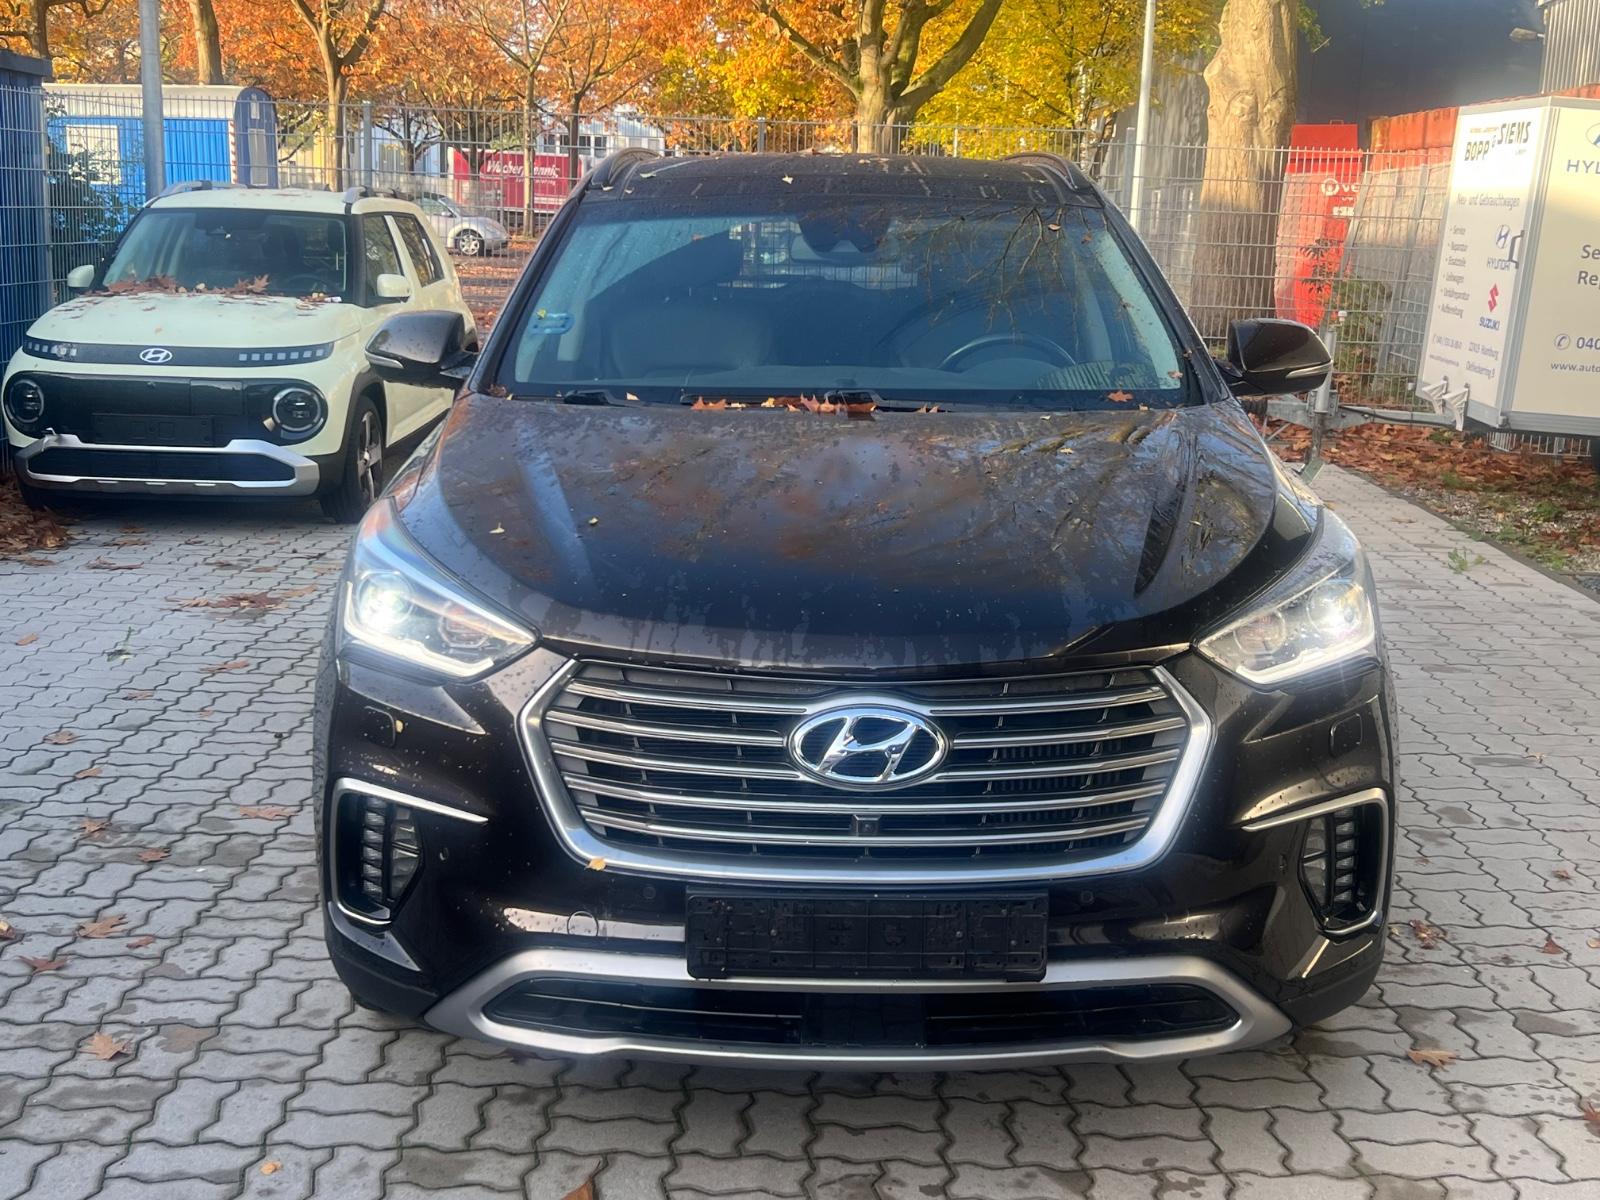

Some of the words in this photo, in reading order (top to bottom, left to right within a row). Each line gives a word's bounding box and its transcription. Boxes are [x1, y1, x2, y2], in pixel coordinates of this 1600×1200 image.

[1464, 139, 1491, 161] BOPP
[1497, 121, 1531, 145] SIEMS
[486, 160, 560, 179] Wucherpennig
[1577, 270, 1600, 290] Re
[1479, 316, 1500, 331] SUZUKI
[1576, 336, 1600, 350] 040
